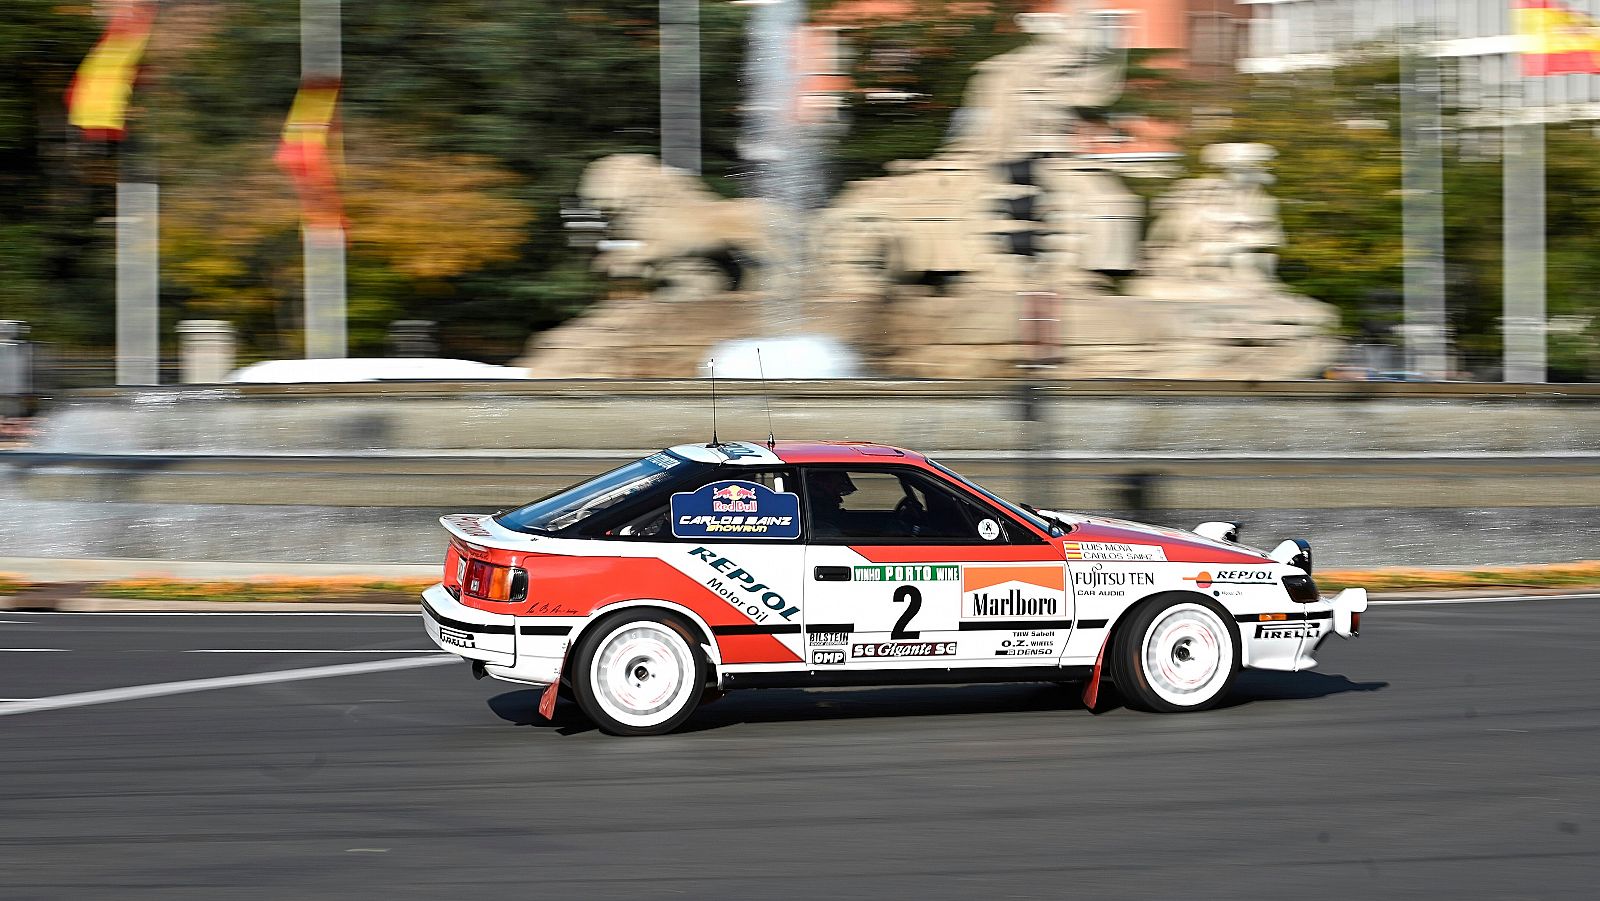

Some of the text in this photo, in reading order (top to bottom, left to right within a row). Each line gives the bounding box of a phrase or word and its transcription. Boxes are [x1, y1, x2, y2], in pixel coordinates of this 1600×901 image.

[713, 501, 758, 512] Red Bull
[680, 515, 792, 526] CARLOS SAINZ
[1081, 543, 1133, 552] LUIS MOYA
[1083, 552, 1124, 560] CARLOS
[855, 566, 959, 581] VINHO PORTO WINE
[1075, 563, 1155, 588] FUJITSU TEN
[1216, 570, 1273, 580] REPSOL
[687, 546, 801, 622] REPSOL
[706, 578, 769, 623] Motor Oil
[973, 589, 1057, 617] Marlboro
[891, 585, 923, 641] 2
[1253, 622, 1320, 639] PIRELLI
[810, 632, 849, 642] BILSTEIN
[1001, 639, 1029, 647] O.Z.
[853, 644, 876, 657] SG
[877, 642, 932, 657] Gigante
[935, 642, 957, 655] SG
[1016, 648, 1053, 656] DENSO
[814, 652, 844, 664] OMP
